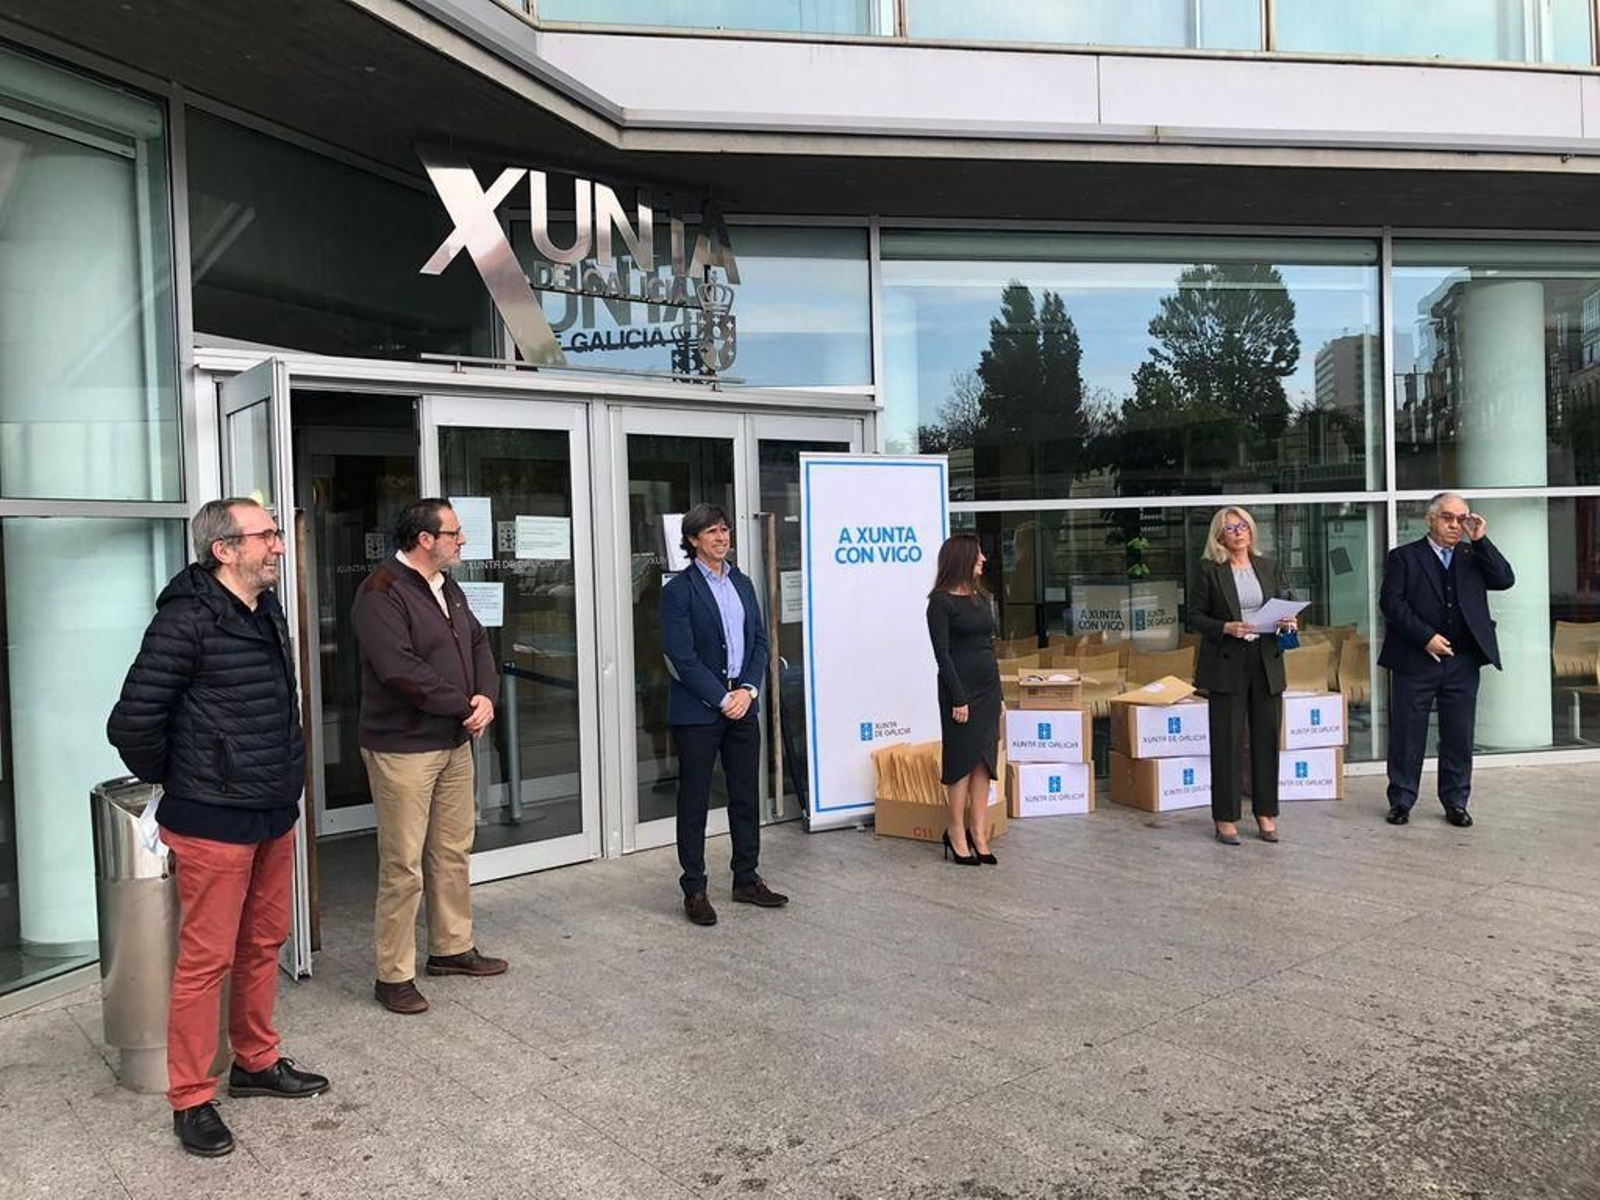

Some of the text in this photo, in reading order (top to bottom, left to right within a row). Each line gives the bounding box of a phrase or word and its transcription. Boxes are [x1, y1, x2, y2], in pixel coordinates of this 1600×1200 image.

[418, 153, 741, 366] XUNTA
[533, 261, 691, 306] DE GALICIA
[571, 327, 665, 353] GALICIA
[839, 526, 917, 544] A XUNTA
[835, 546, 922, 564] CON VIGO
[466, 560, 501, 570] XUNTA
[1080, 609, 1122, 620] A XUNTA
[1078, 621, 1125, 632] CON VIGO
[875, 721, 897, 729] XUNTA
[1319, 725, 1340, 733] GALICIA
[875, 727, 912, 738] DE GALICIA
[1180, 734, 1207, 742] GALICIA
[1048, 741, 1079, 749] GALICIA
